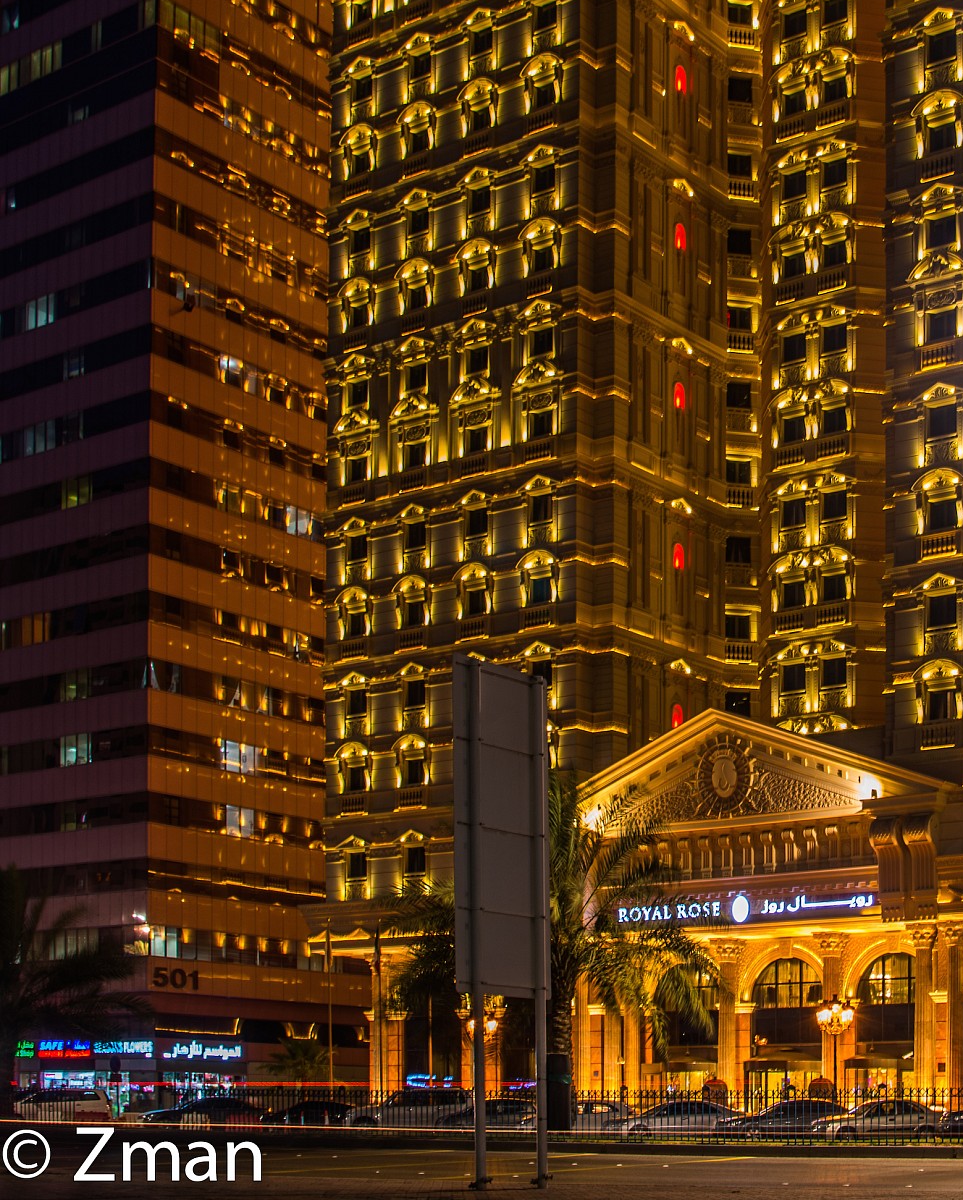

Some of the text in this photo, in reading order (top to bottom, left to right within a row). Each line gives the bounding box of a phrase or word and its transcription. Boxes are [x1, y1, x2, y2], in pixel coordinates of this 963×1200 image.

[617, 901, 721, 923] ROYAL ROSE
[152, 966, 200, 991] 501
[39, 1040, 64, 1050] SAFE
